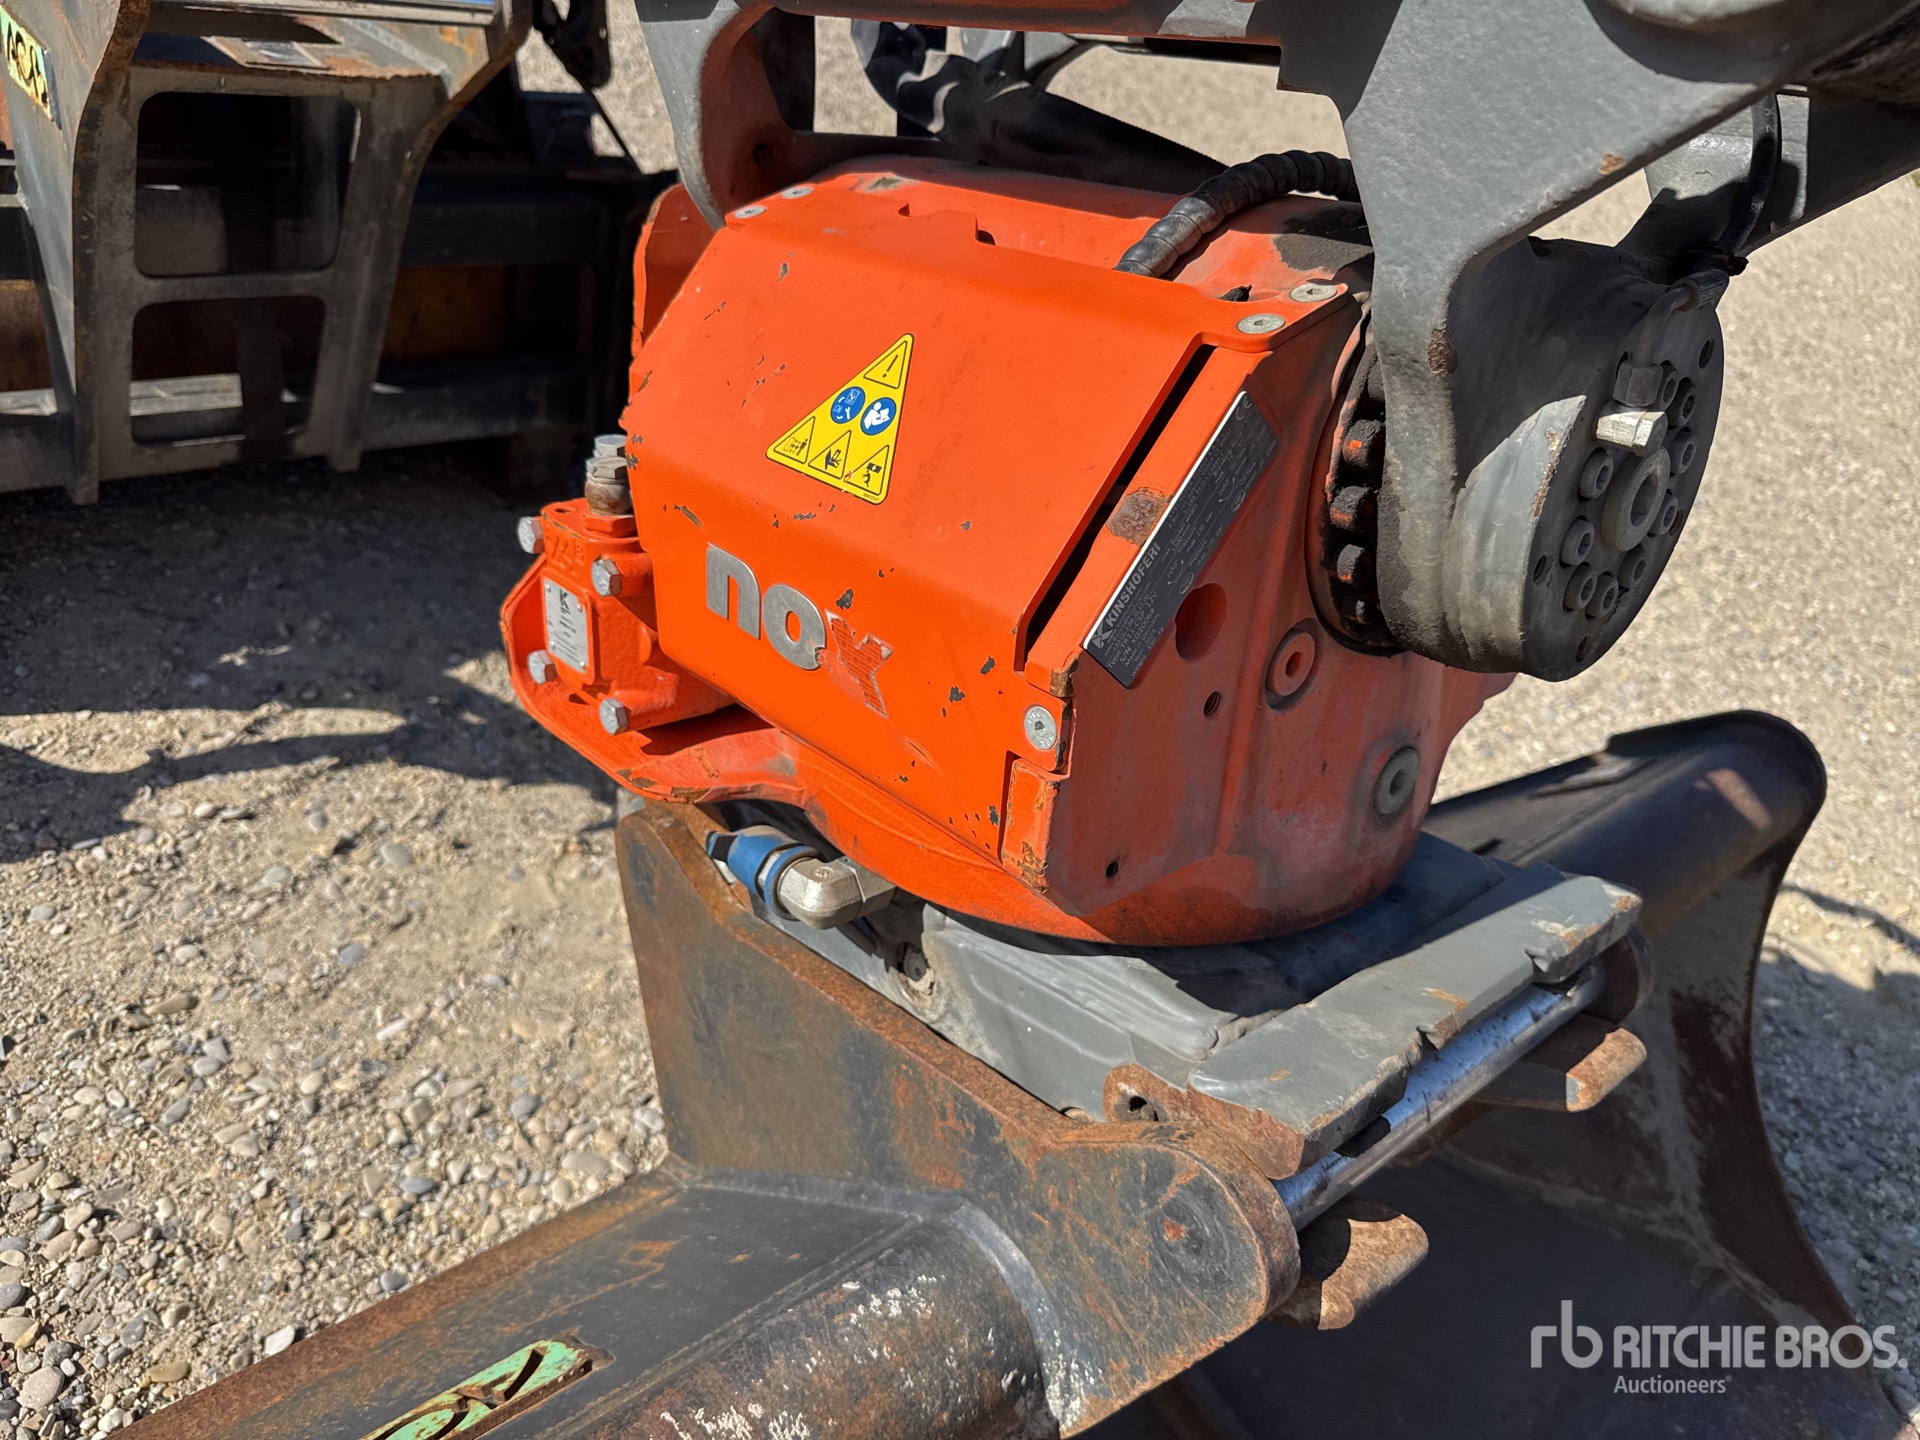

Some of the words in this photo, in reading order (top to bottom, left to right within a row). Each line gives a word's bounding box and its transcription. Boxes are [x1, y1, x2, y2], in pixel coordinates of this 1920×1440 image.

[1233, 394, 1253, 423] CE
[1107, 648, 1122, 669] Type
[1145, 590, 1158, 608] 12V
[1140, 611, 1161, 641] Germany
[1119, 645, 1132, 664] S/N
